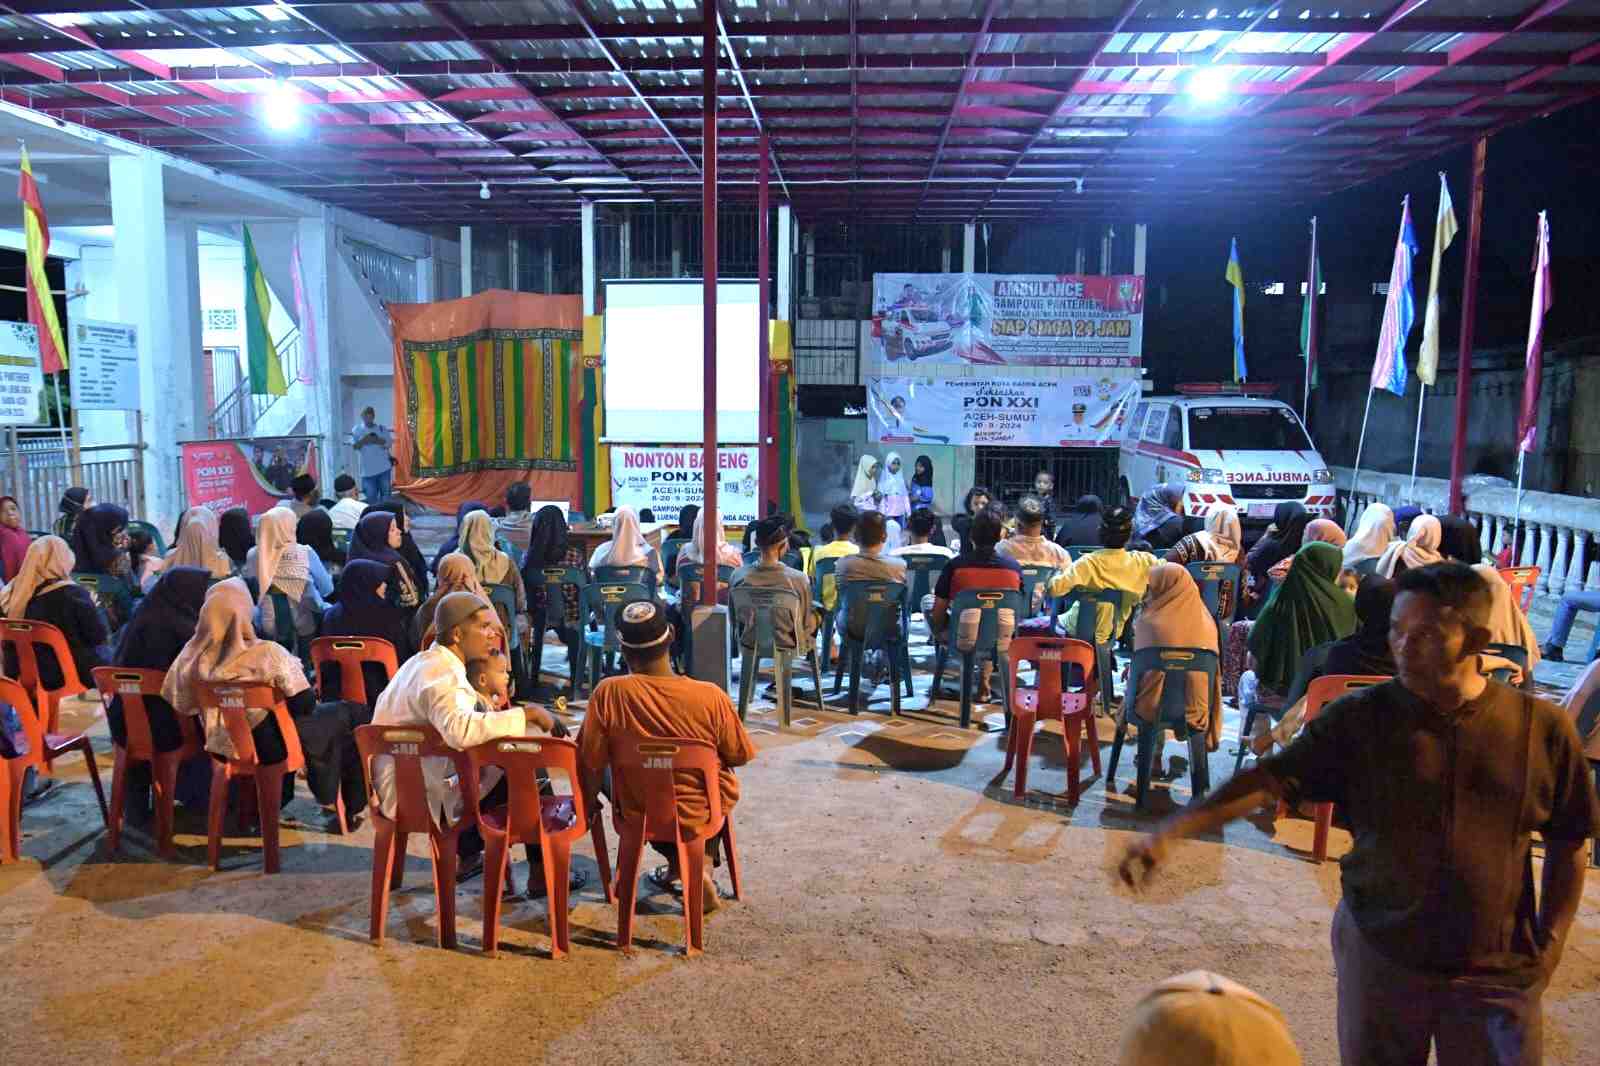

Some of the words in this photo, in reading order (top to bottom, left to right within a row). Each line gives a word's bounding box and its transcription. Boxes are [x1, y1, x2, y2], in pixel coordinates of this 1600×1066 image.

[998, 281, 1084, 297] AMBULANCE
[992, 320, 1026, 335] SIAP
[1075, 320, 1095, 336] 24
[1097, 320, 1131, 336] JAM
[963, 397, 1002, 408] PON
[1007, 397, 1040, 409] XXI
[964, 412, 1037, 421] ACEH-SUMUT
[624, 452, 684, 468] NONTON
[689, 452, 748, 469] BAENG
[651, 472, 688, 482] PON
[692, 472, 721, 482] XI
